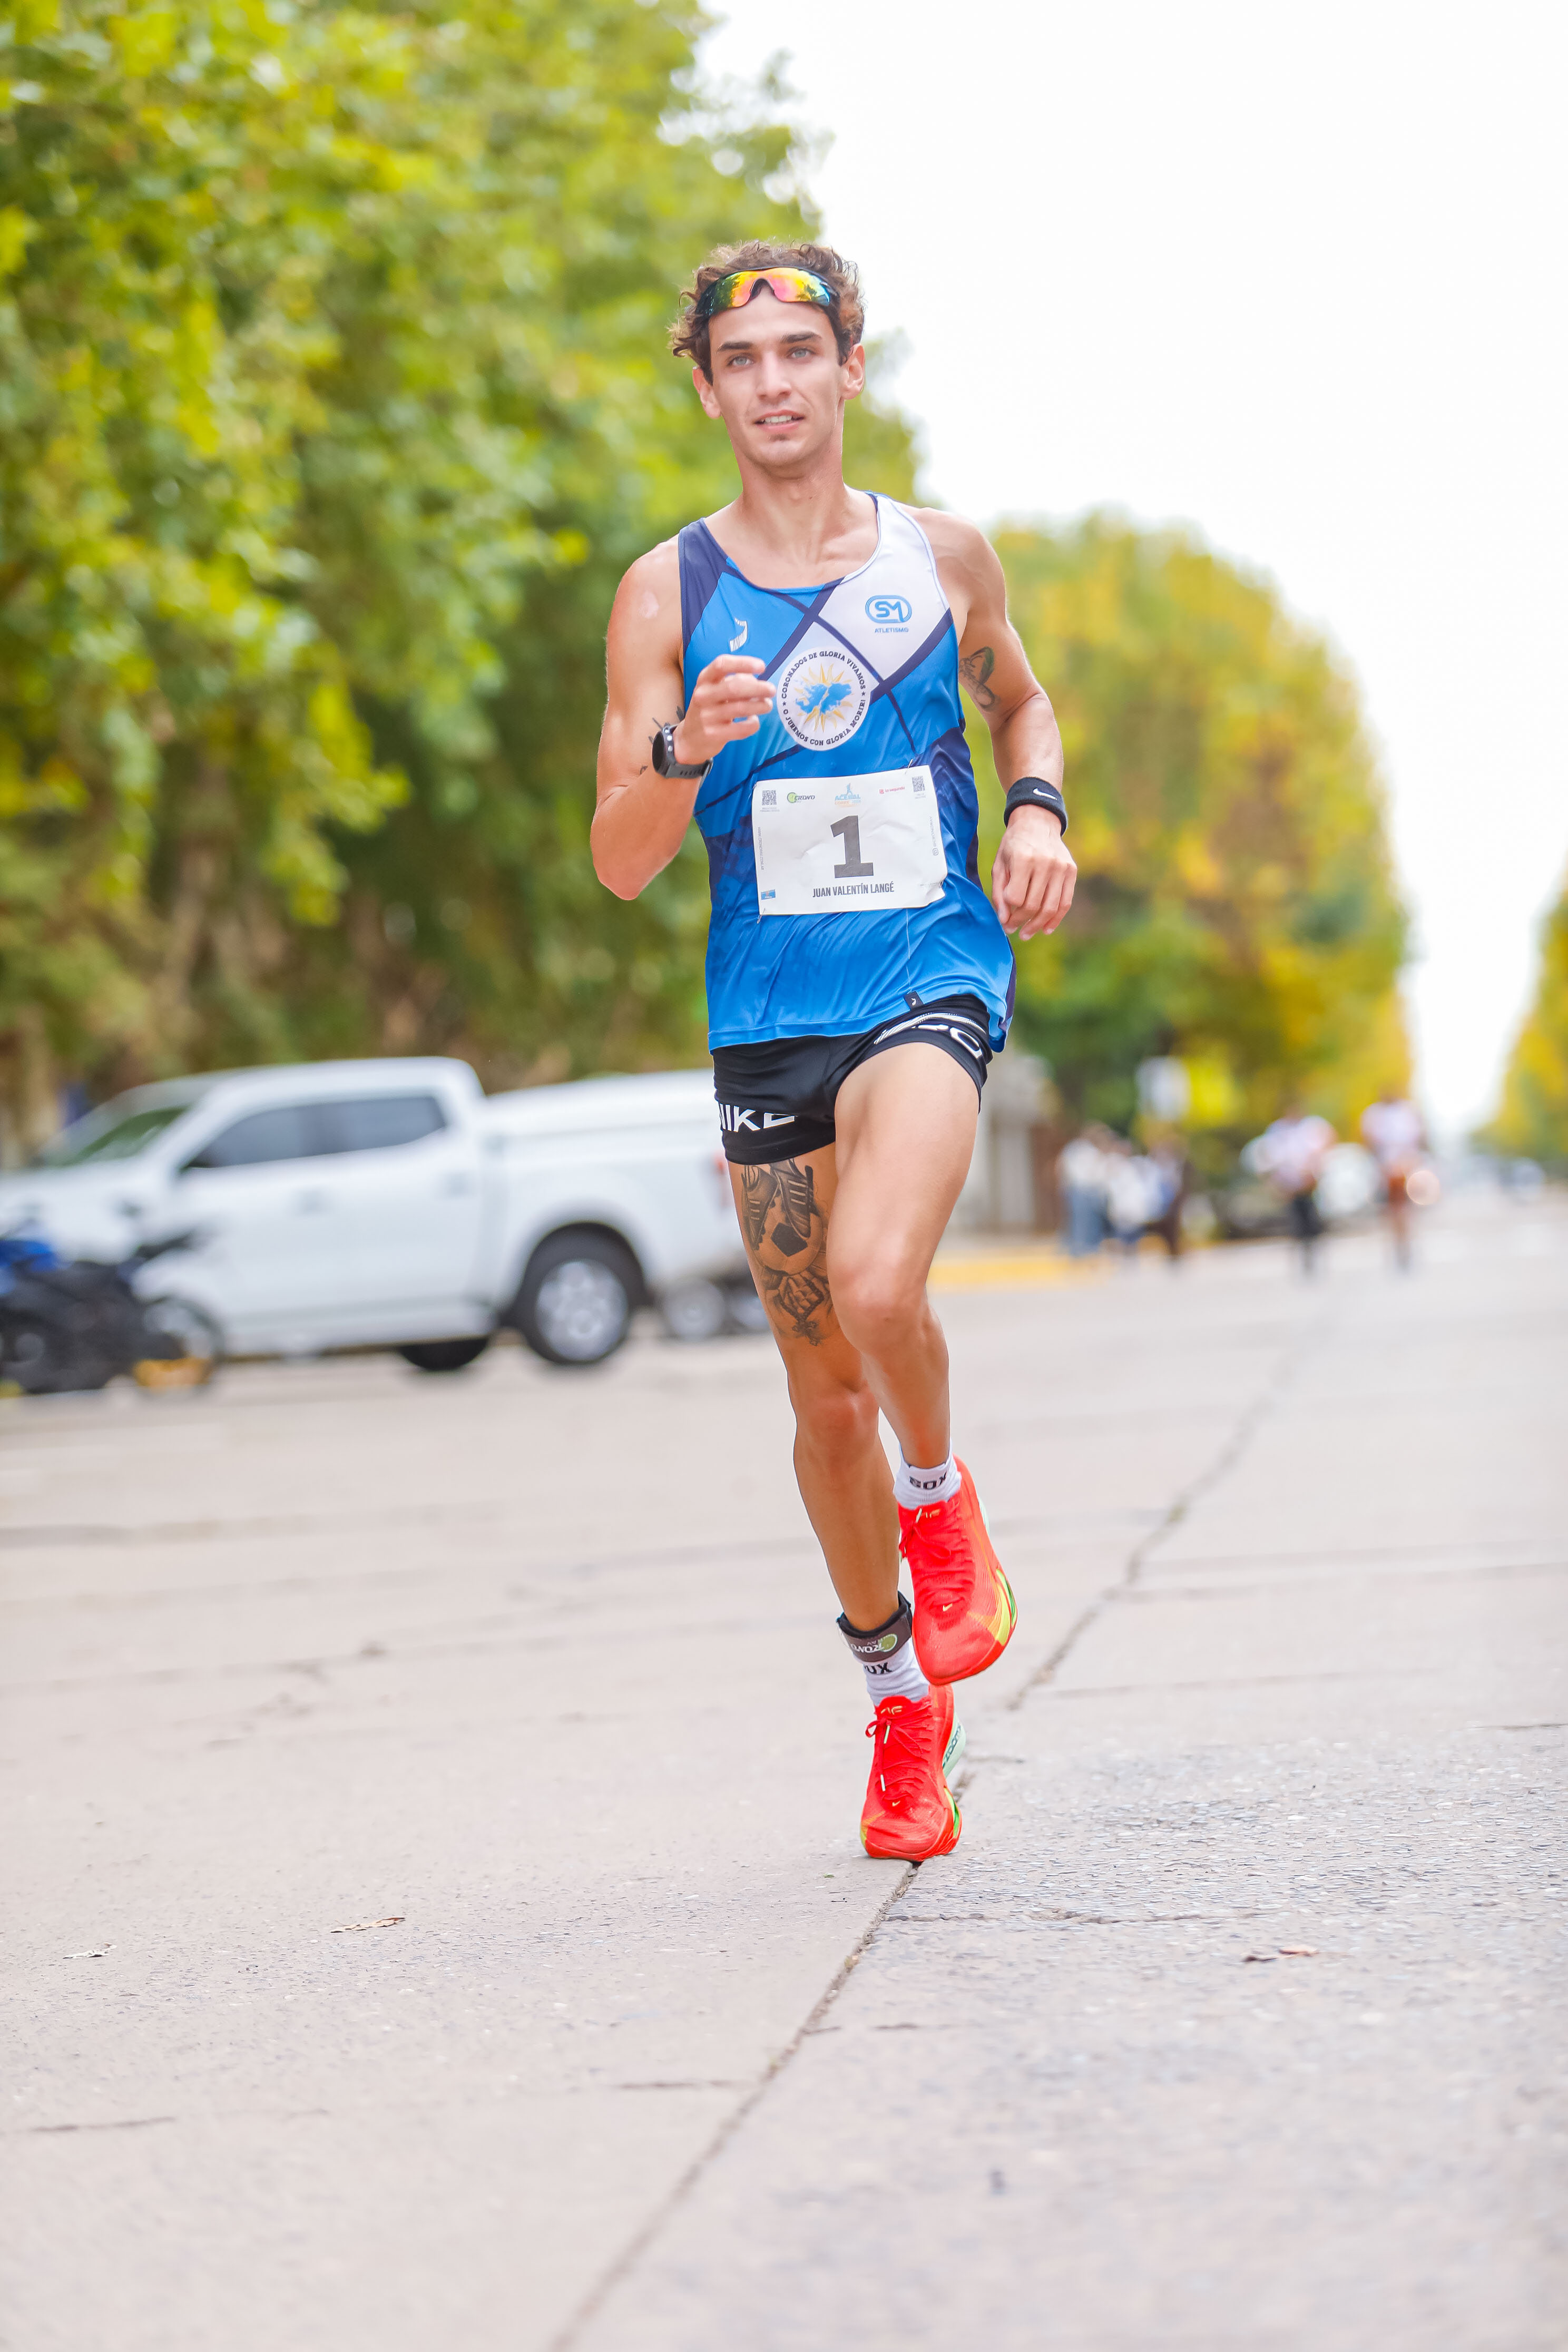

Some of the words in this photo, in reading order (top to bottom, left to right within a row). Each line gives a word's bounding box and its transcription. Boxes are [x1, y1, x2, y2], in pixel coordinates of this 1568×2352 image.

[875, 601, 904, 623] SM
[781, 656, 808, 699] CORONADOS
[809, 652, 817, 660] DE
[819, 650, 845, 661] GLORIA
[847, 658, 866, 690] VIVAMOS
[786, 716, 809, 742] JUREMOS
[826, 728, 851, 745] GLORIA
[830, 815, 874, 878] 1
[812, 887, 831, 897] JUAN
[832, 883, 868, 896] VALENTÍN
[870, 881, 895, 894] LANGÉ
